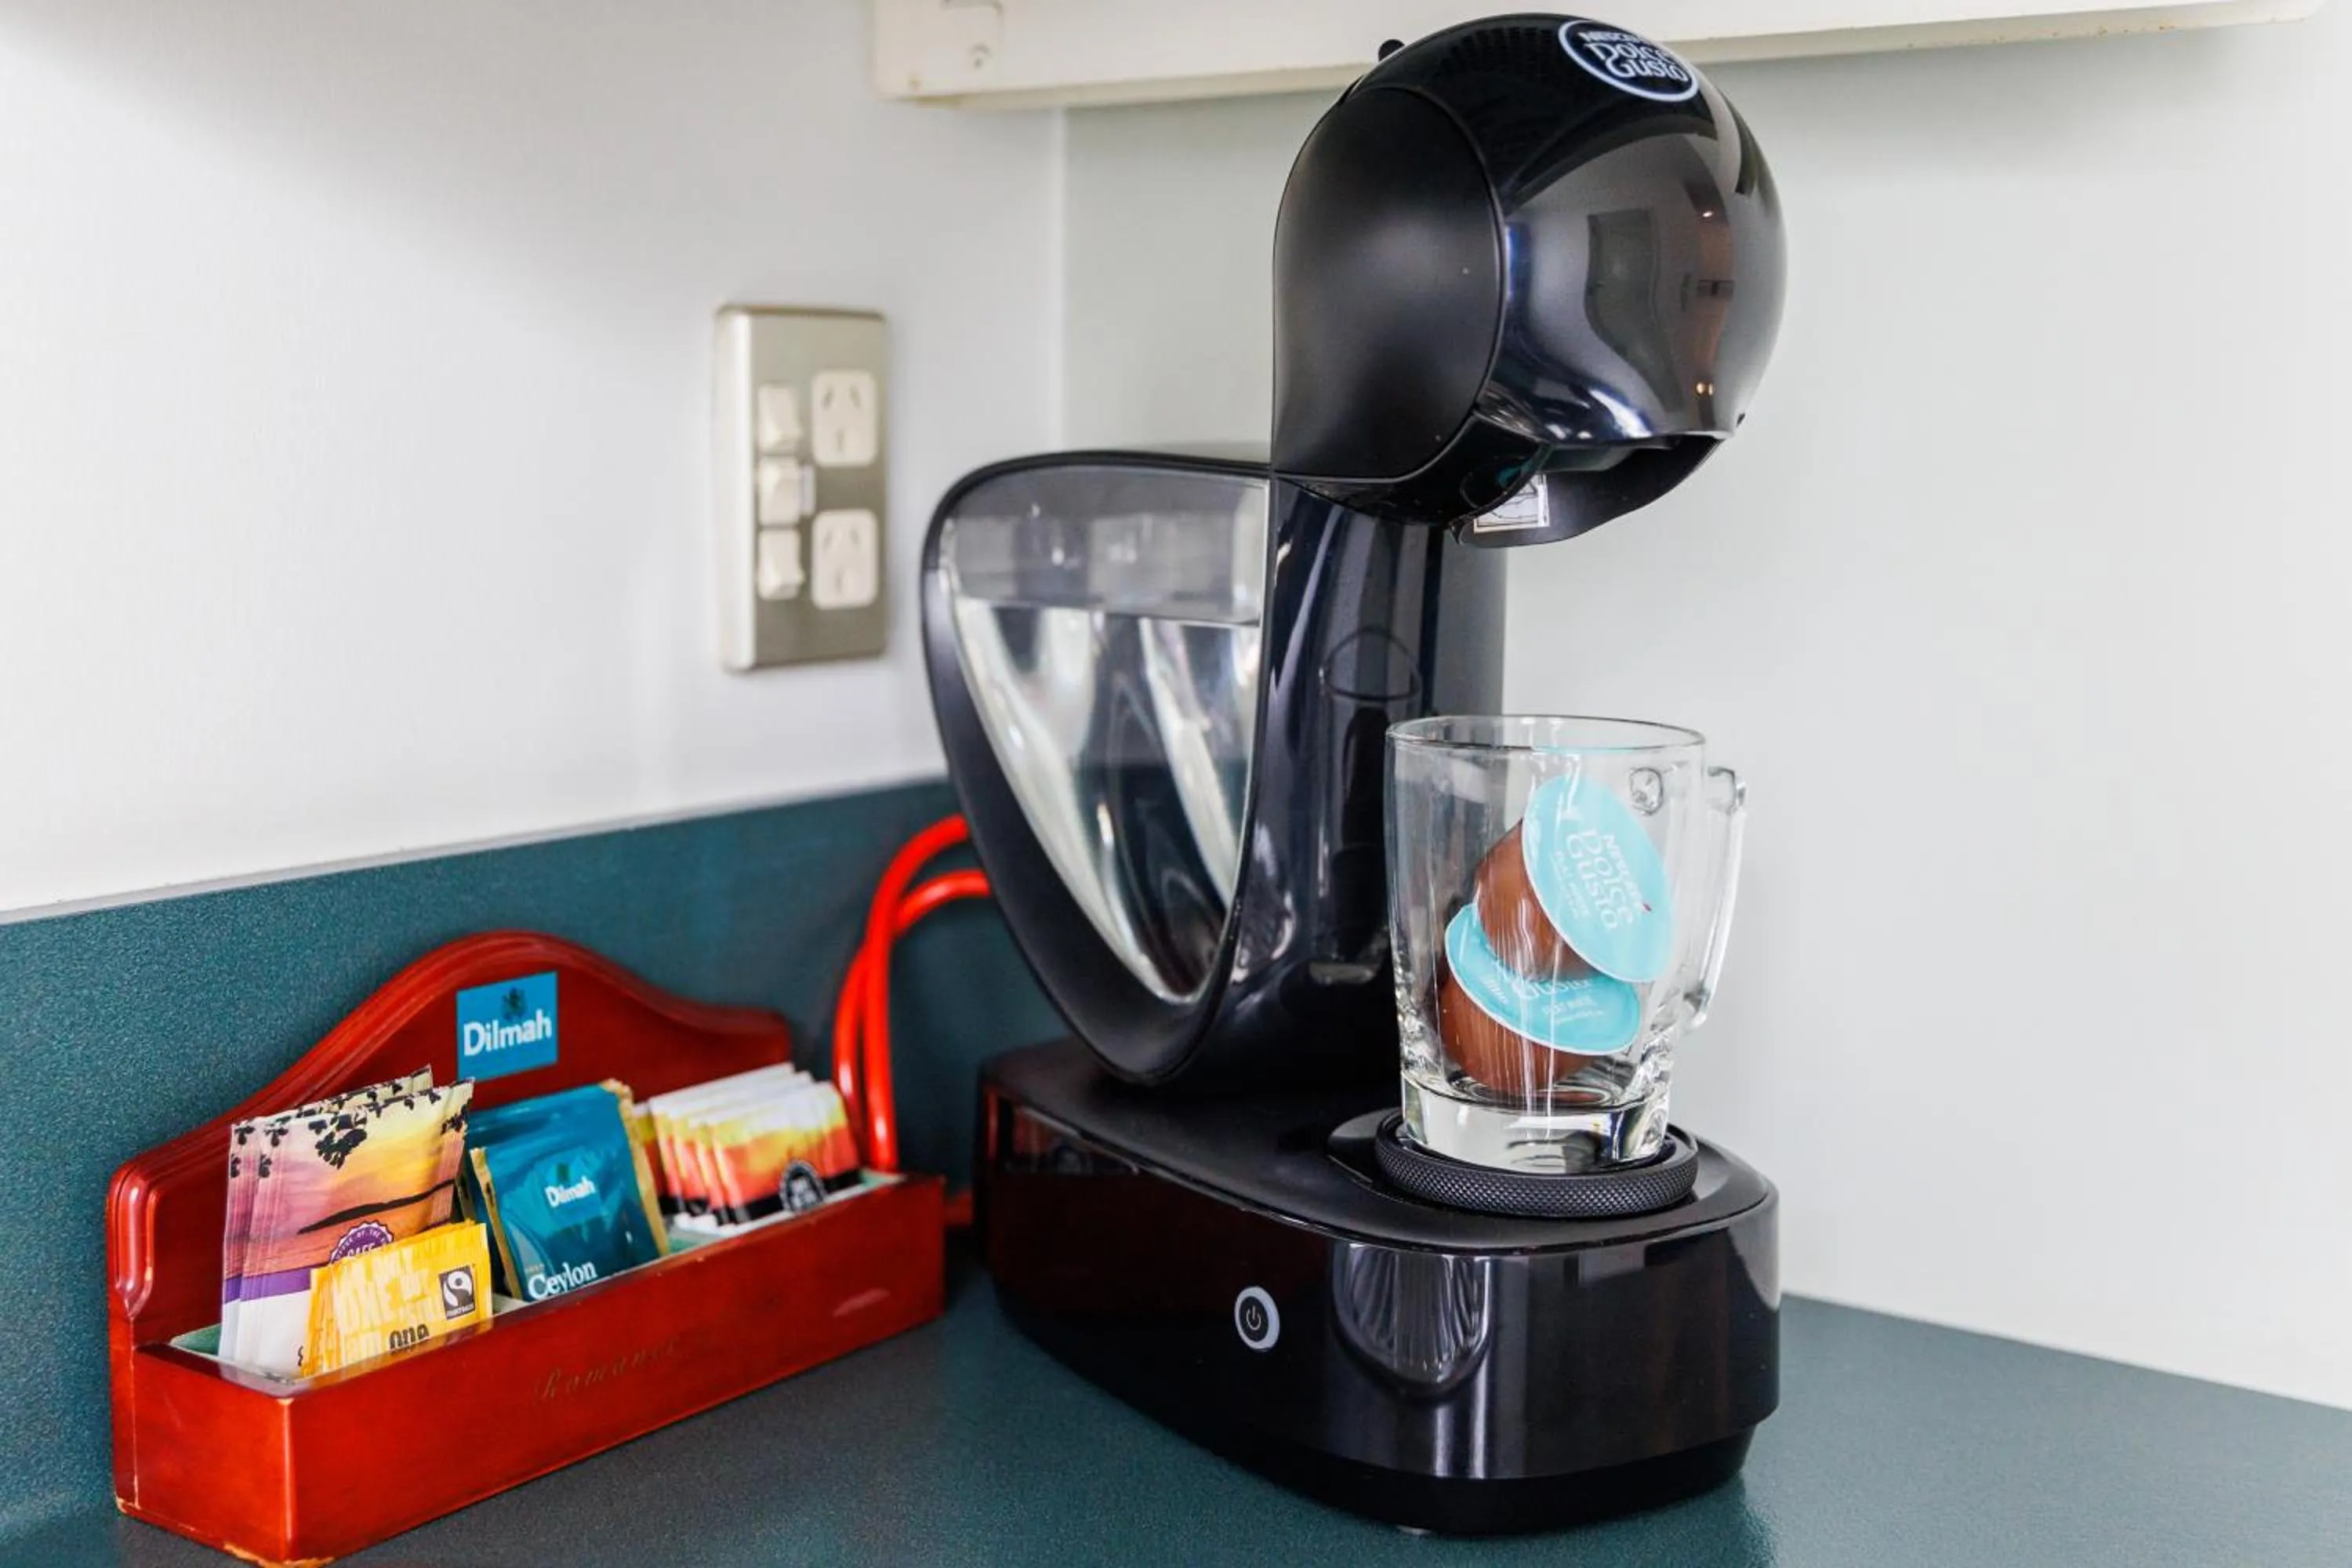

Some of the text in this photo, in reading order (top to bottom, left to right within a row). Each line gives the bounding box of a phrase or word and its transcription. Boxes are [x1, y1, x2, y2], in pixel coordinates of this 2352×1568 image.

[1606, 56, 1689, 82] Gusto
[1566, 834, 1618, 929] Gusto
[463, 1008, 553, 1056] Dilmah
[545, 1175, 596, 1207] Dilmah
[528, 1261, 598, 1300] Ceylon
